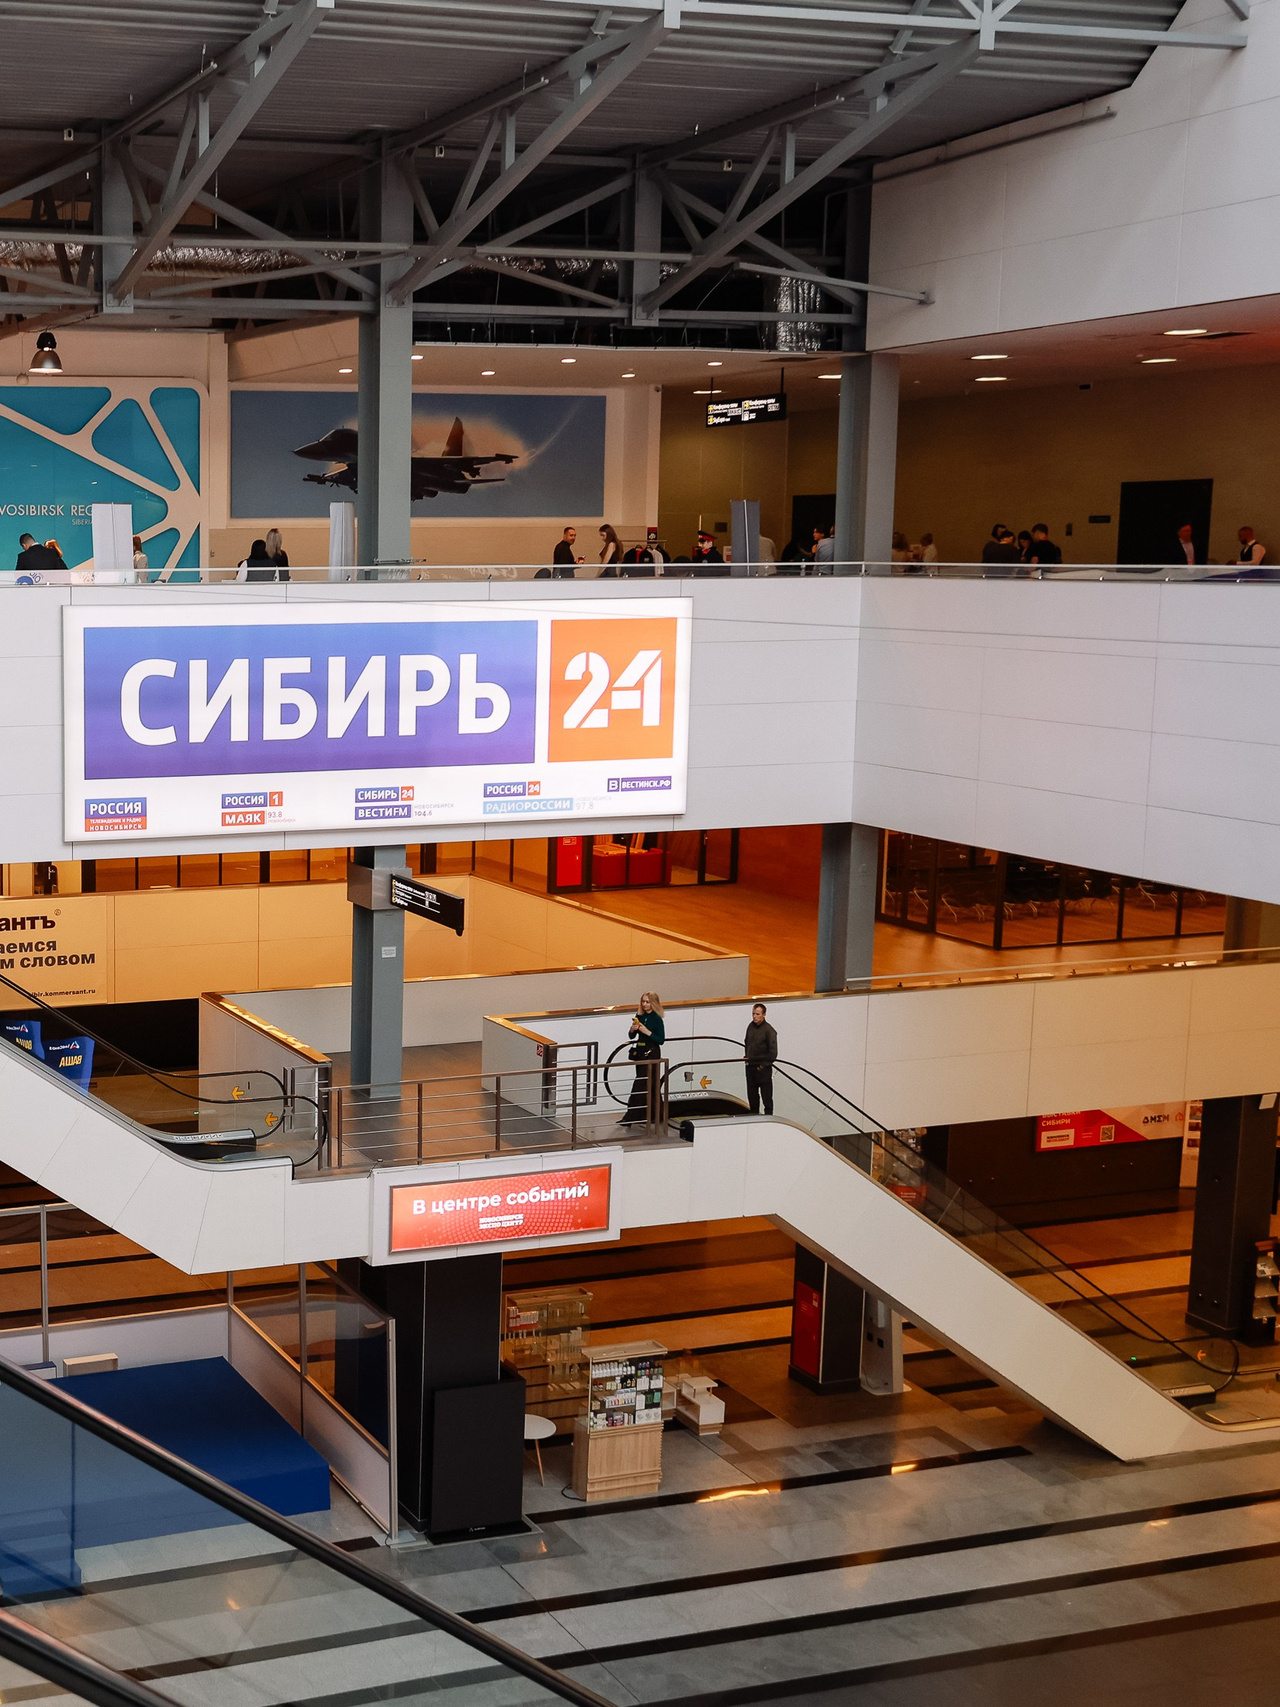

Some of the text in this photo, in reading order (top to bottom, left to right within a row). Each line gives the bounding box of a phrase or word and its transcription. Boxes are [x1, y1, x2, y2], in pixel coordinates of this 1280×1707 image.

[71, 504, 93, 516] REG
[119, 649, 662, 747] СИБИРЬ 24
[357, 789, 413, 800] СИБИРЬ 24
[486, 783, 540, 795] РОССИЯ 24
[225, 793, 280, 806] РОССИЯ 1
[89, 801, 142, 815] РОССИЯ
[225, 813, 262, 824] МАЯК
[89, 823, 143, 831] НОВОСИБИРСК
[19, 953, 96, 968] словом
[31, 988, 96, 999] ibir.kommersant.ru
[1041, 1118, 1071, 1127] СИБИРИ
[412, 1181, 590, 1215] В центре событий
